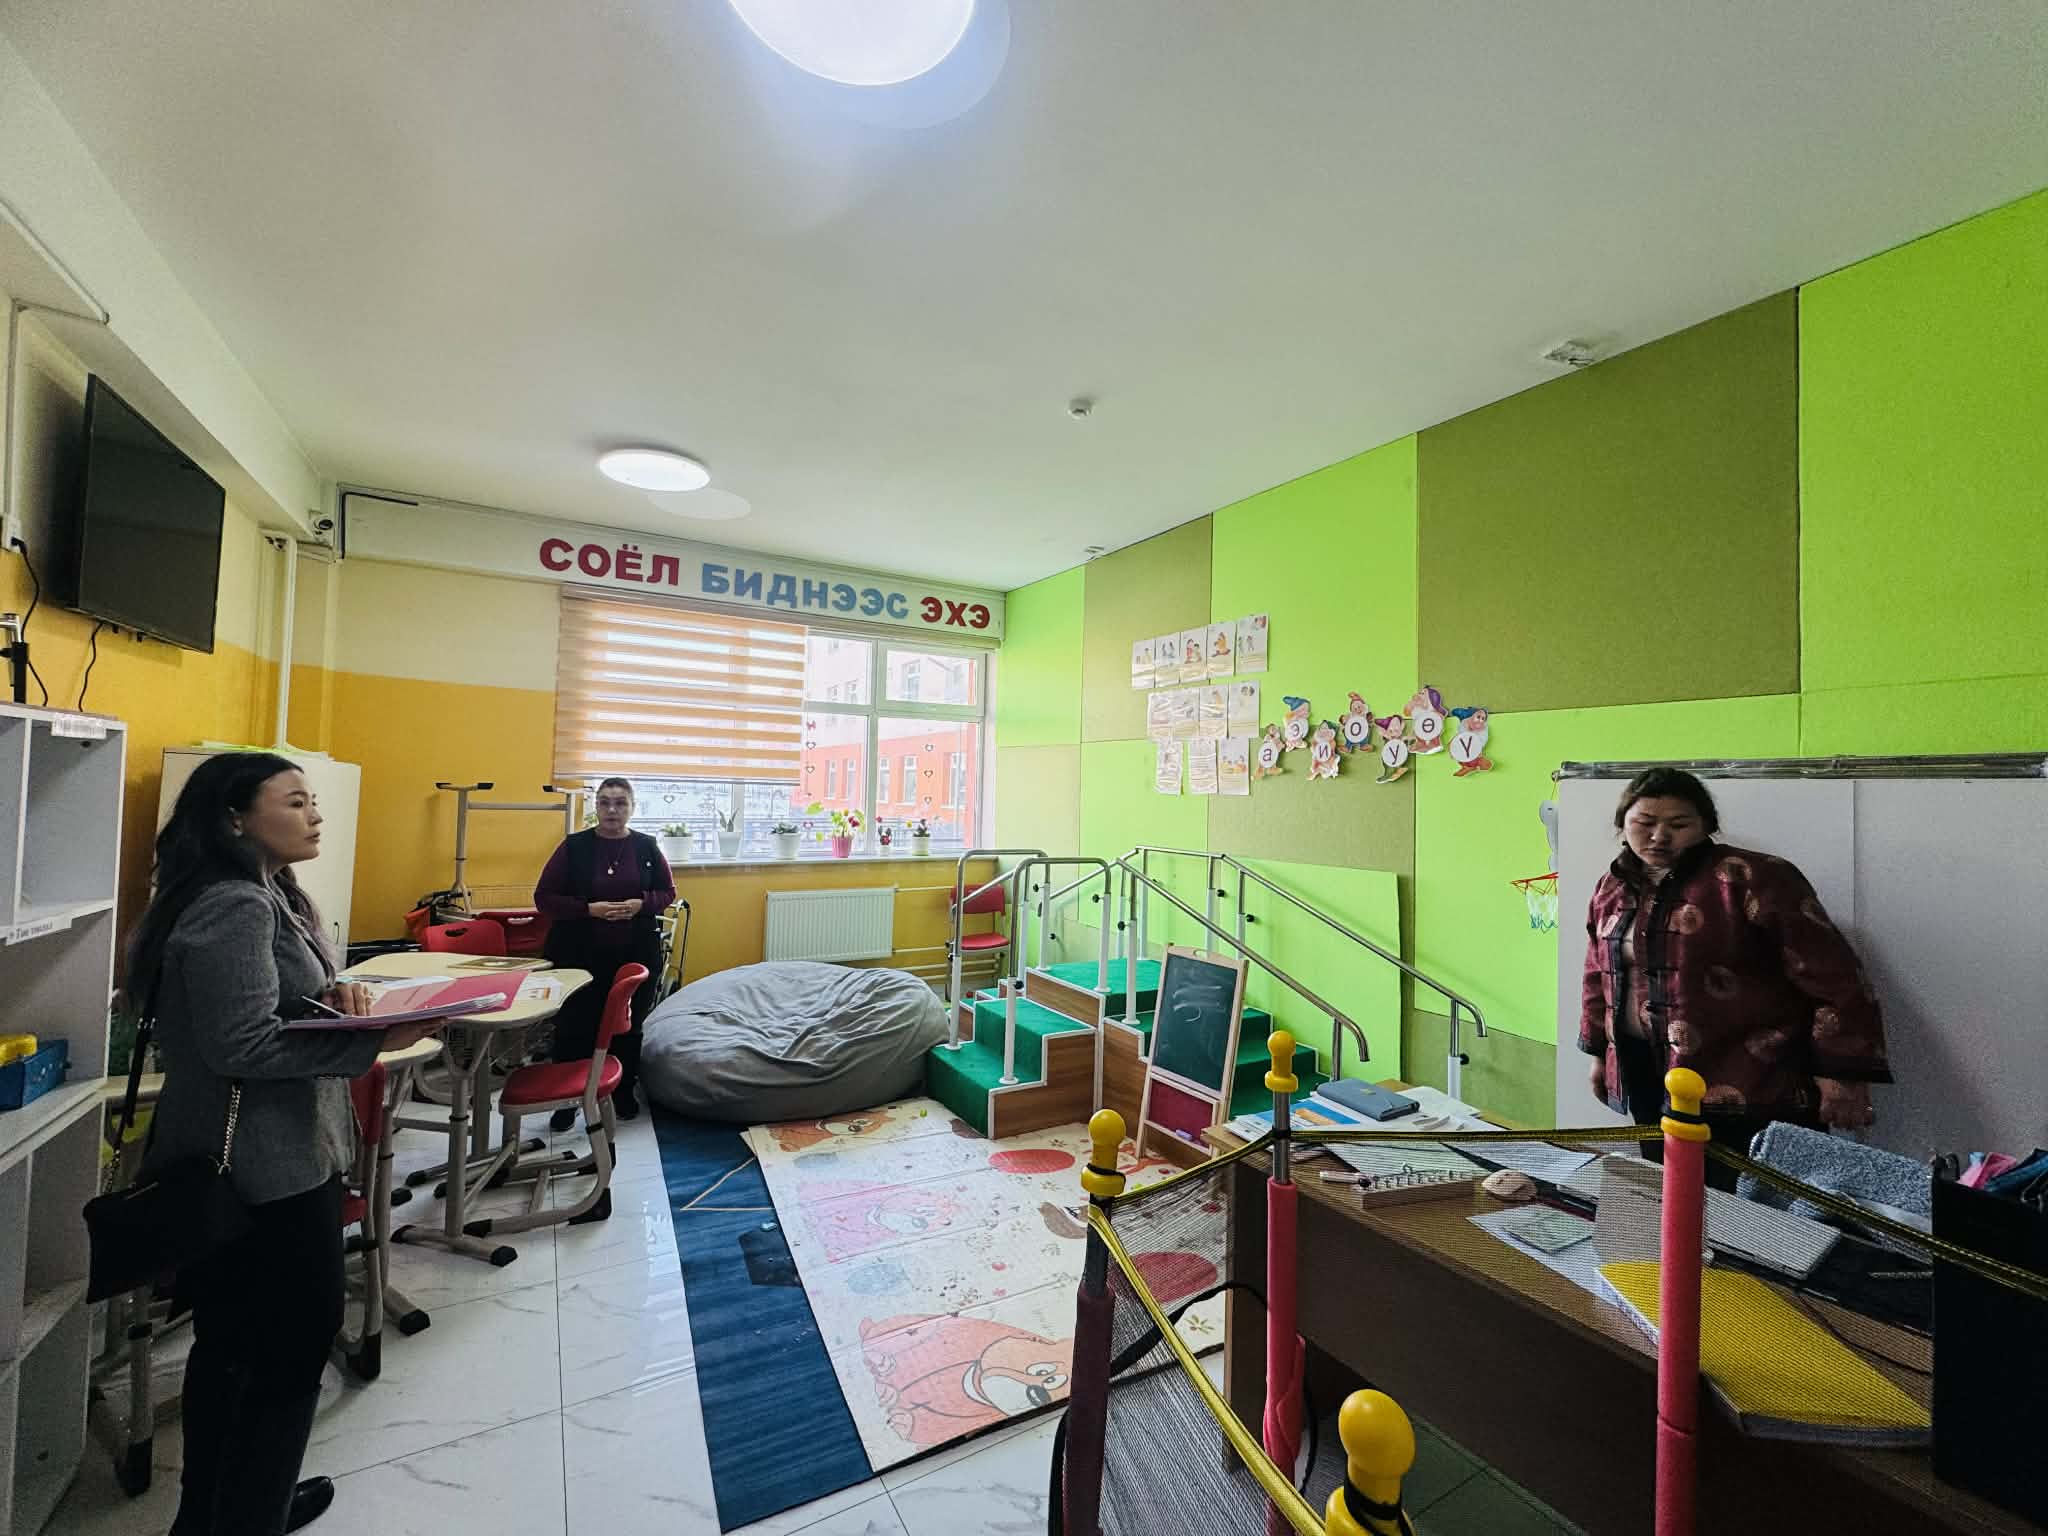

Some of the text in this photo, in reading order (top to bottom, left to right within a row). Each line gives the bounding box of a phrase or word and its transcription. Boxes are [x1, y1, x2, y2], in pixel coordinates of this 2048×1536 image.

[540, 537, 991, 629] СОЁЛ БИДНЭЭС ЭХЭ
[1262, 747, 1273, 762] а
[1291, 721, 1301, 733] э
[1318, 746, 1329, 759] и
[1350, 720, 1362, 735] о
[1389, 743, 1400, 765] у
[1422, 719, 1435, 733] ө
